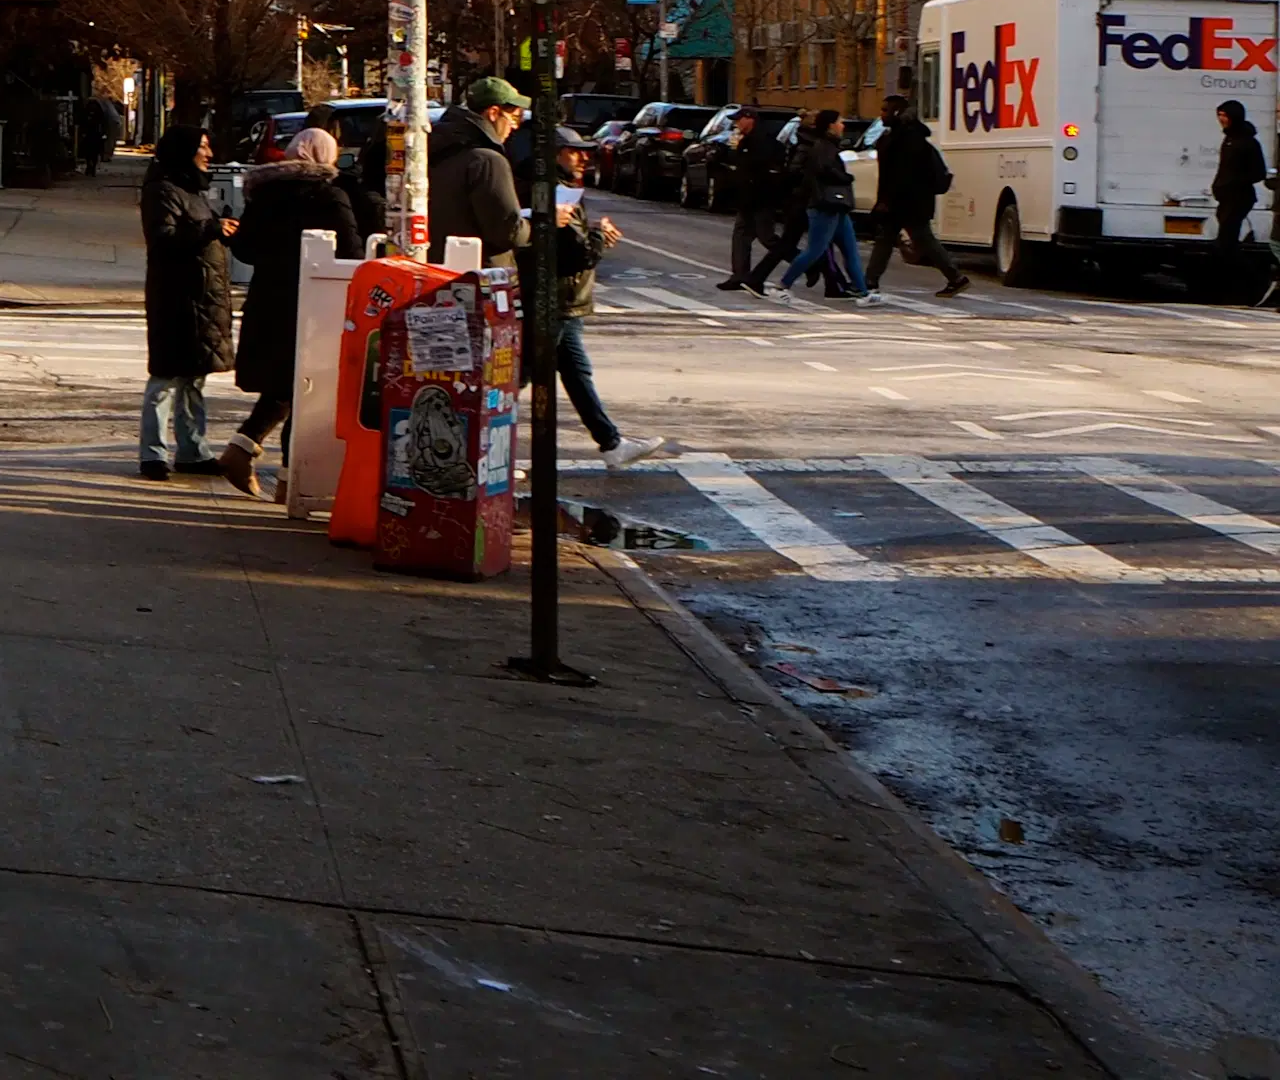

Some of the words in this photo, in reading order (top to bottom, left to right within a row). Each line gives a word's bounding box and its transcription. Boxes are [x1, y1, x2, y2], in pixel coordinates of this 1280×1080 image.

[1099, 14, 1279, 72] FedEx
[949, 22, 1040, 133] FedEx
[1200, 74, 1257, 89] Ground
